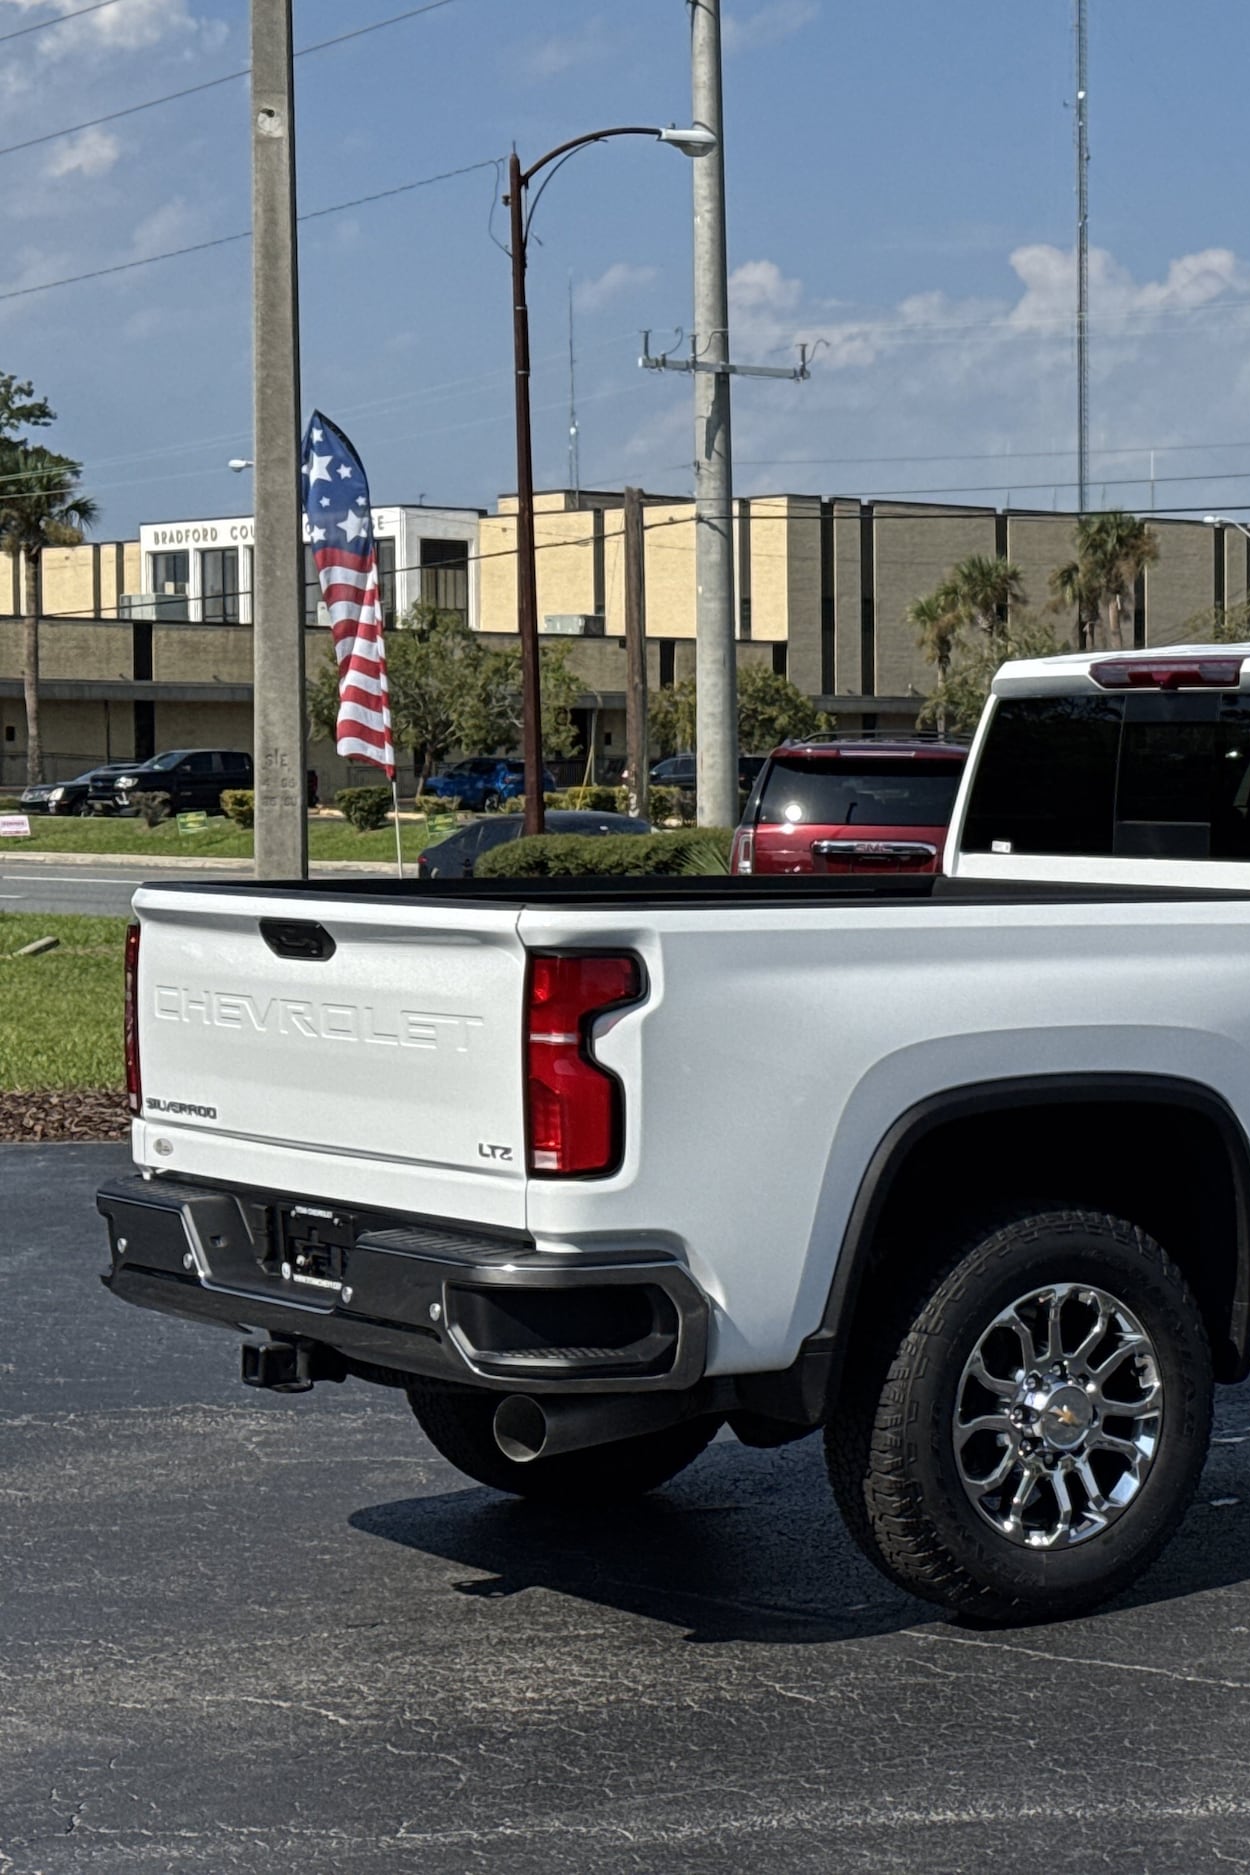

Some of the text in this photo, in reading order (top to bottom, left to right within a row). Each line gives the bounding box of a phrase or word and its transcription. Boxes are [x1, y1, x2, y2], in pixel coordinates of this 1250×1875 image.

[153, 524, 255, 546] BRADFORD COU
[154, 985, 483, 1052] CHEVROLET
[478, 1142, 513, 1162] LTZ
